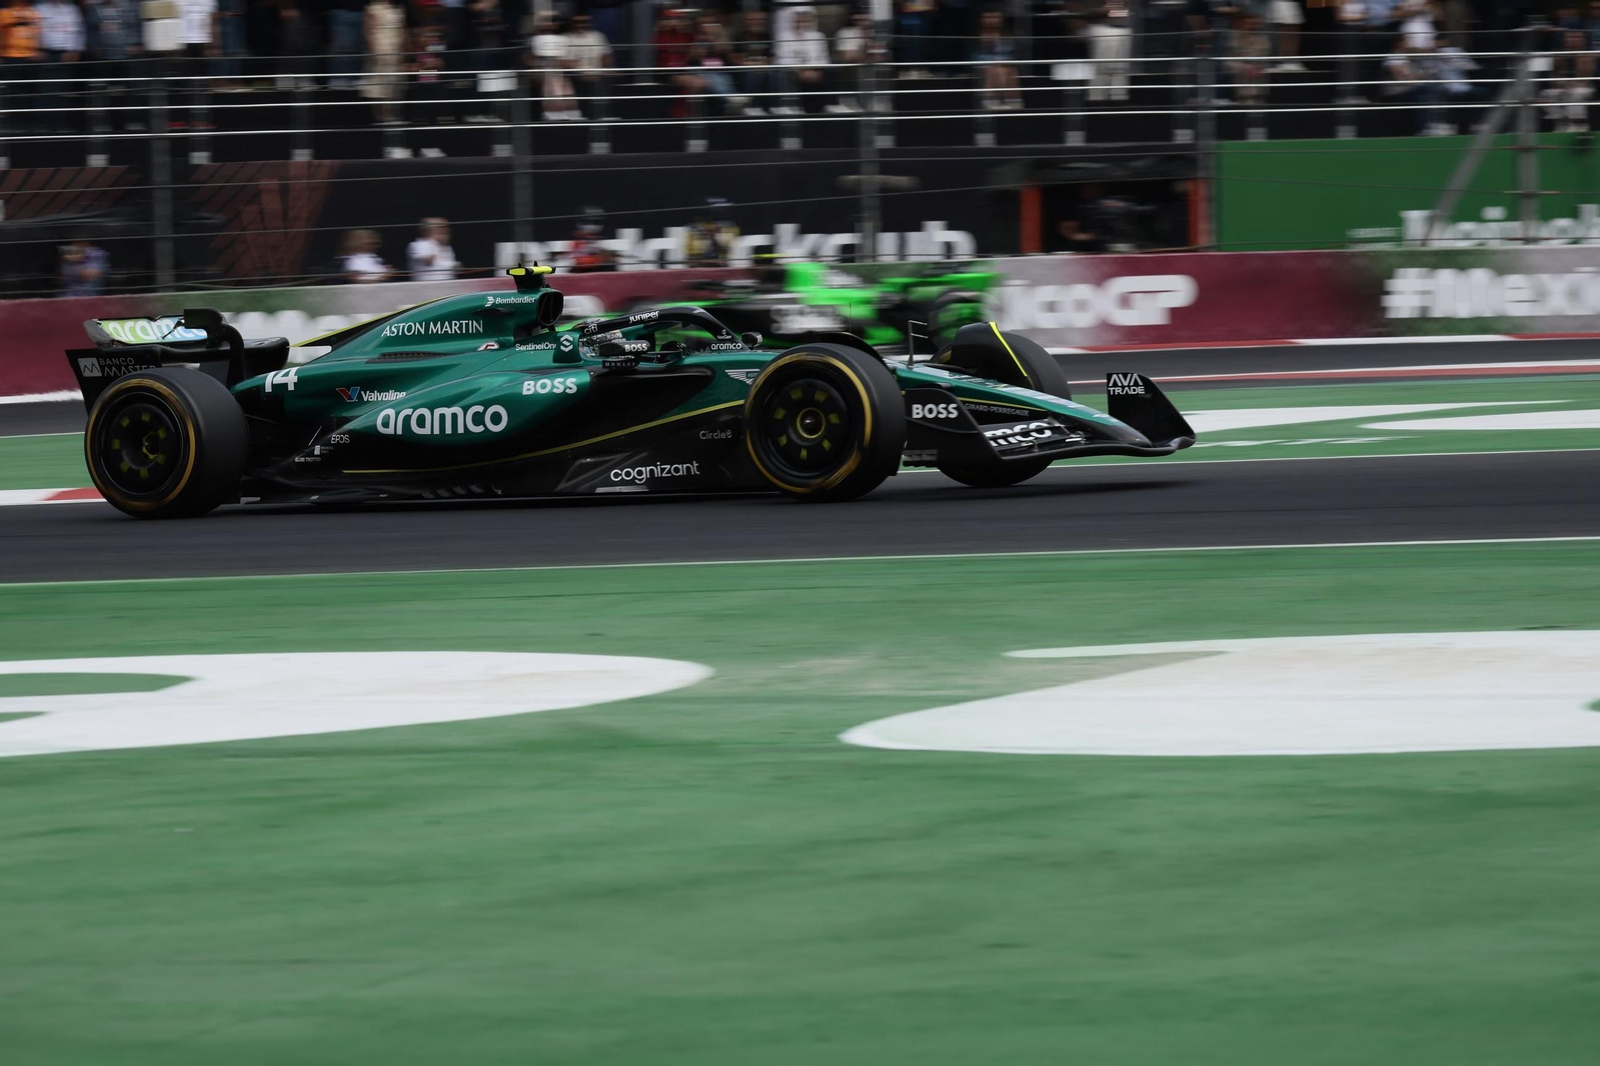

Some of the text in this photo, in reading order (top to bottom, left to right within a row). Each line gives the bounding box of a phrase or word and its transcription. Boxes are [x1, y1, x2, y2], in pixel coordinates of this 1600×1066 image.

[380, 320, 483, 337] ASTON MARTIN
[584, 323, 599, 335] citi
[624, 343, 648, 352] BOSS
[711, 342, 742, 350] aramco
[99, 357, 135, 366] BANCO
[265, 367, 298, 393] 14
[1108, 374, 1142, 385] AVA
[522, 377, 578, 396] BOSS
[1108, 386, 1146, 395] TRADE
[361, 389, 407, 402] Valvoline
[911, 403, 959, 419] BOSS
[376, 404, 509, 435] aramco
[330, 434, 350, 444] EPOS
[610, 461, 700, 484] cognizant
